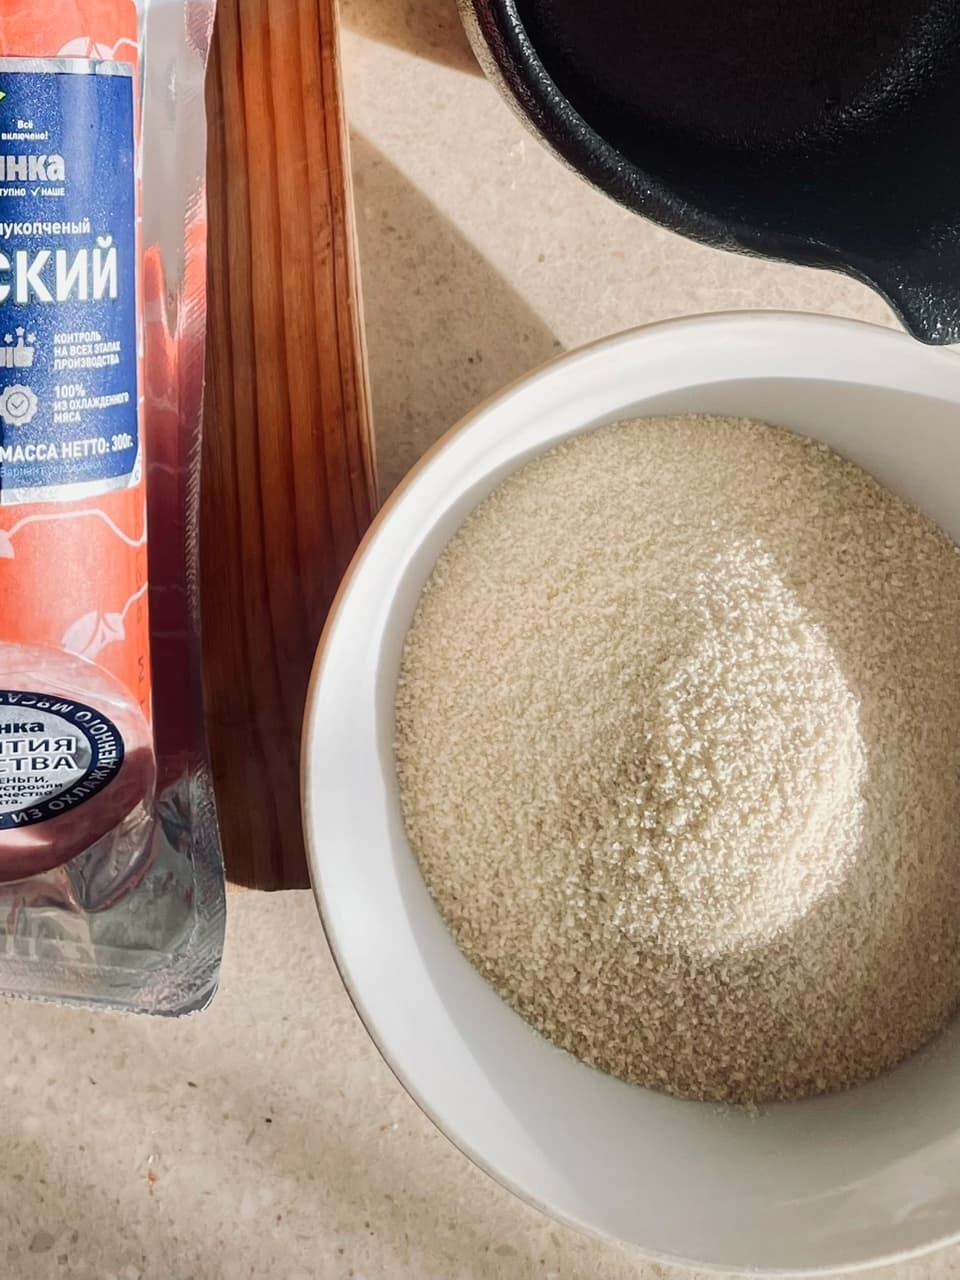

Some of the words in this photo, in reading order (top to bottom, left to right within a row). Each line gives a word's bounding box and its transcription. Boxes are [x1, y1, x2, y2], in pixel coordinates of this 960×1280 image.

[17, 119, 33, 129] Всё
[41, 187, 65, 197] НАШЕ
[53, 330, 102, 344] КОНТРОЛЬ
[54, 346, 68, 357] НА
[70, 344, 93, 356] ВСЕХ
[95, 340, 121, 353] ЭТАПАХ
[54, 354, 120, 370] ПРОИЗВОДСТВА
[54, 383, 86, 398] 100%
[54, 400, 68, 411] ИЗ
[54, 411, 81, 423] МЯСА
[62, 437, 111, 459] НЕТТО:
[111, 432, 134, 452] 300г.
[11, 808, 43, 823] ИЗ
[48, 711, 121, 811] ОХЛАЖДЕННОГО
